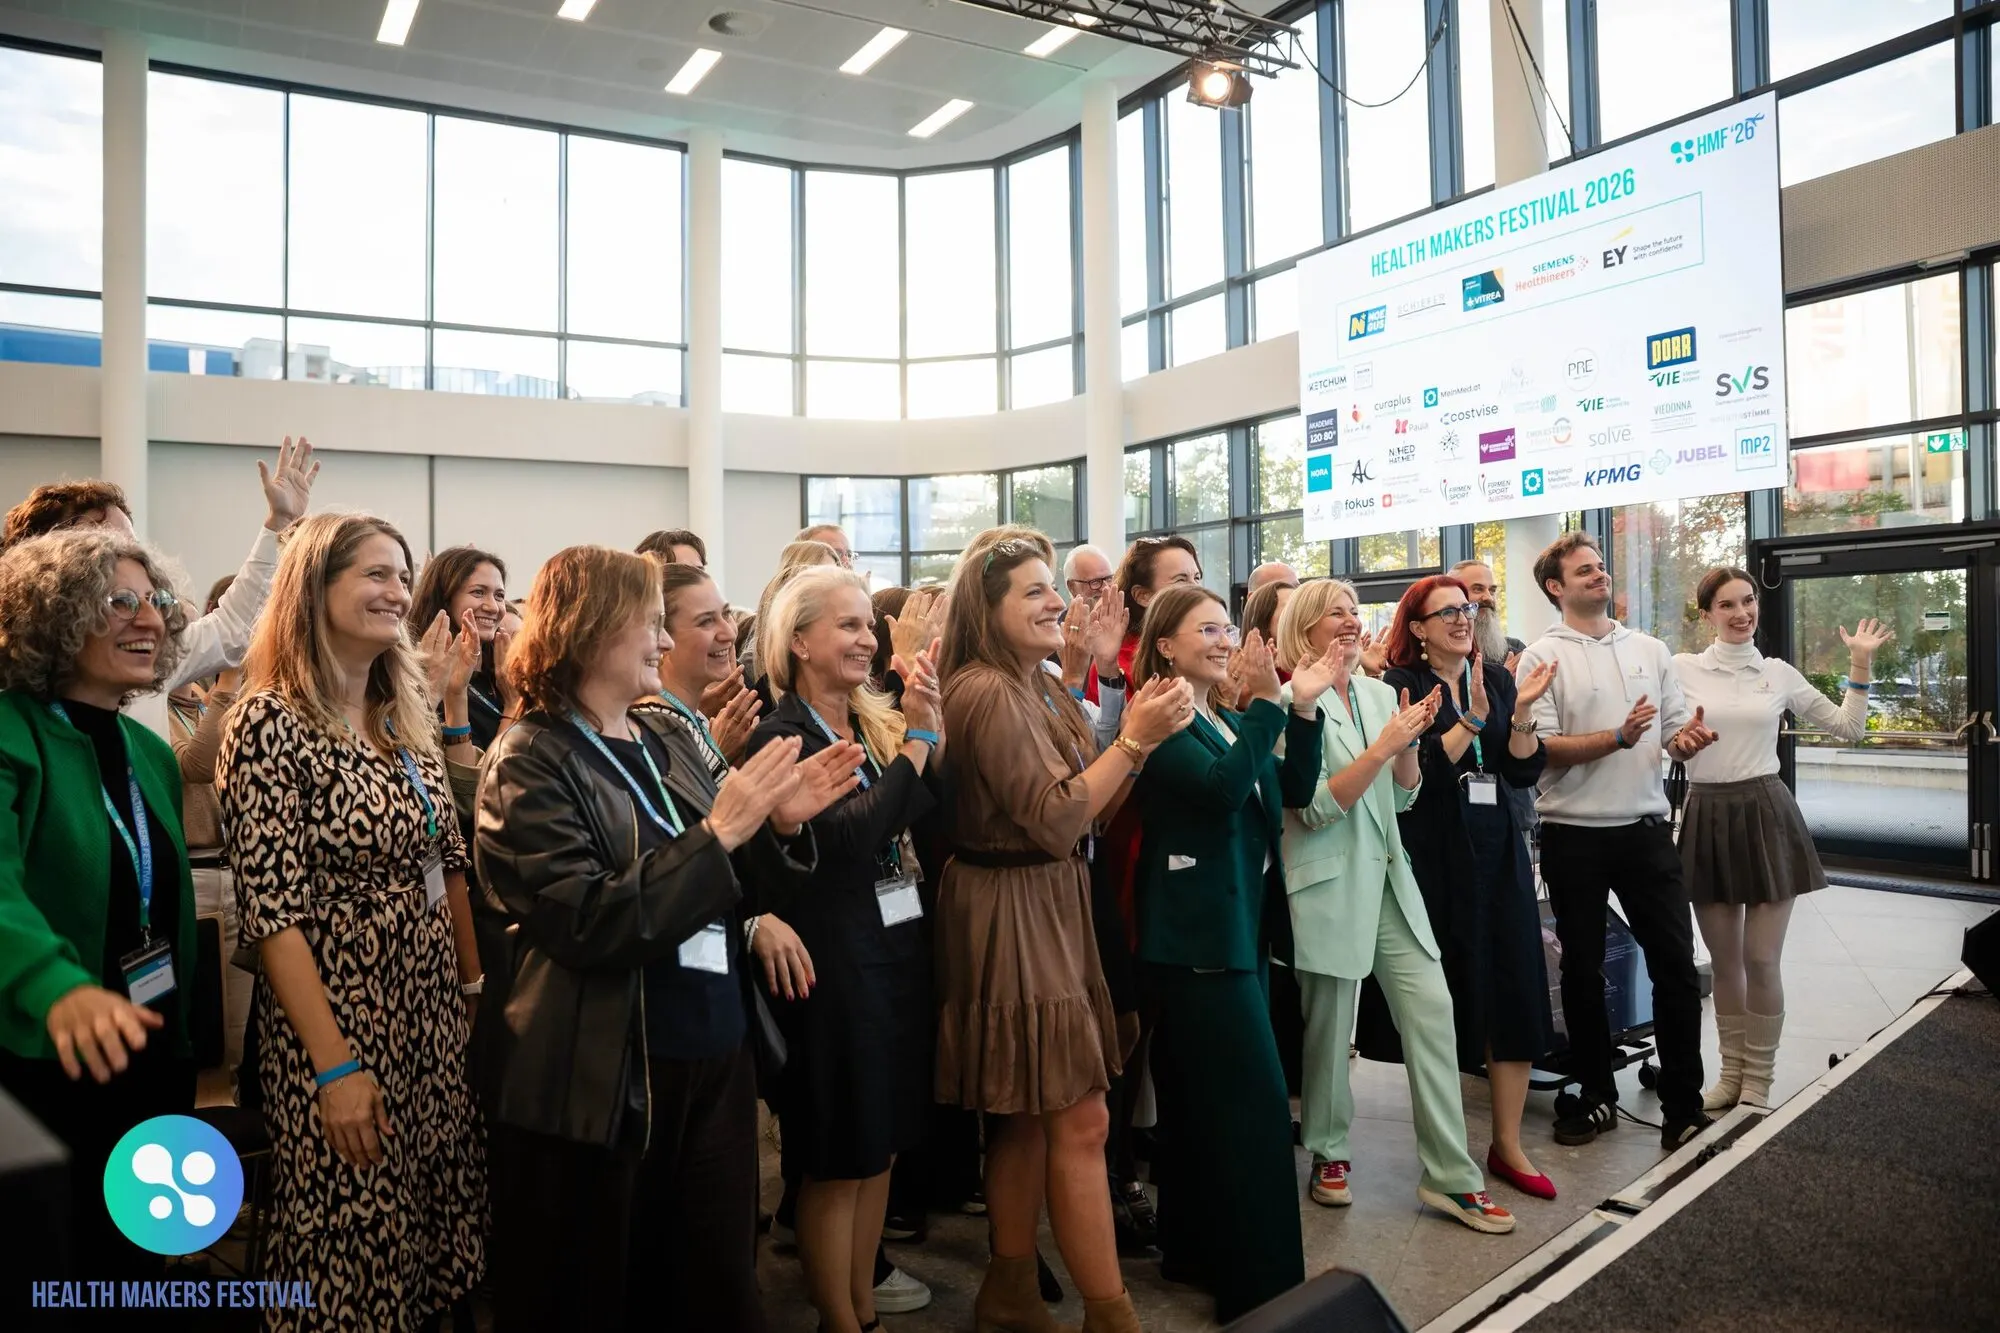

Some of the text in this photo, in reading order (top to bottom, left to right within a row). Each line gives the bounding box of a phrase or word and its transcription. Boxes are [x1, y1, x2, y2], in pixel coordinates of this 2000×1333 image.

[1697, 127, 1728, 156] HMF
[1371, 168, 1636, 277] HEALTH MAKERS FESTIVAL 2026
[1633, 234, 1683, 254] Shape the future
[1633, 242, 1683, 261] with confidence
[1532, 254, 1576, 275] SIEMENS
[1602, 245, 1628, 269] EY
[1515, 268, 1576, 292] Healthineers
[1474, 290, 1502, 305] VITREA
[1308, 376, 1347, 391] KETCHUM
[1656, 370, 1681, 387] VIE
[1715, 366, 1770, 397] SVS
[1374, 394, 1411, 411] curaplus
[1583, 397, 1604, 412] VIE
[1654, 400, 1692, 415] VIEDONNA
[1450, 404, 1499, 422] costvise
[1308, 418, 1334, 430] AKADEMIE
[1409, 422, 1429, 432] Paula
[1675, 445, 1728, 464] JUBEL
[1310, 468, 1329, 478] NORA
[1584, 463, 1642, 487] KPMG
[1488, 487, 1508, 496] SPORT
[1345, 497, 1375, 510] fokus
[129, 780, 152, 887] HEALTH MAKERS FESTIVAL
